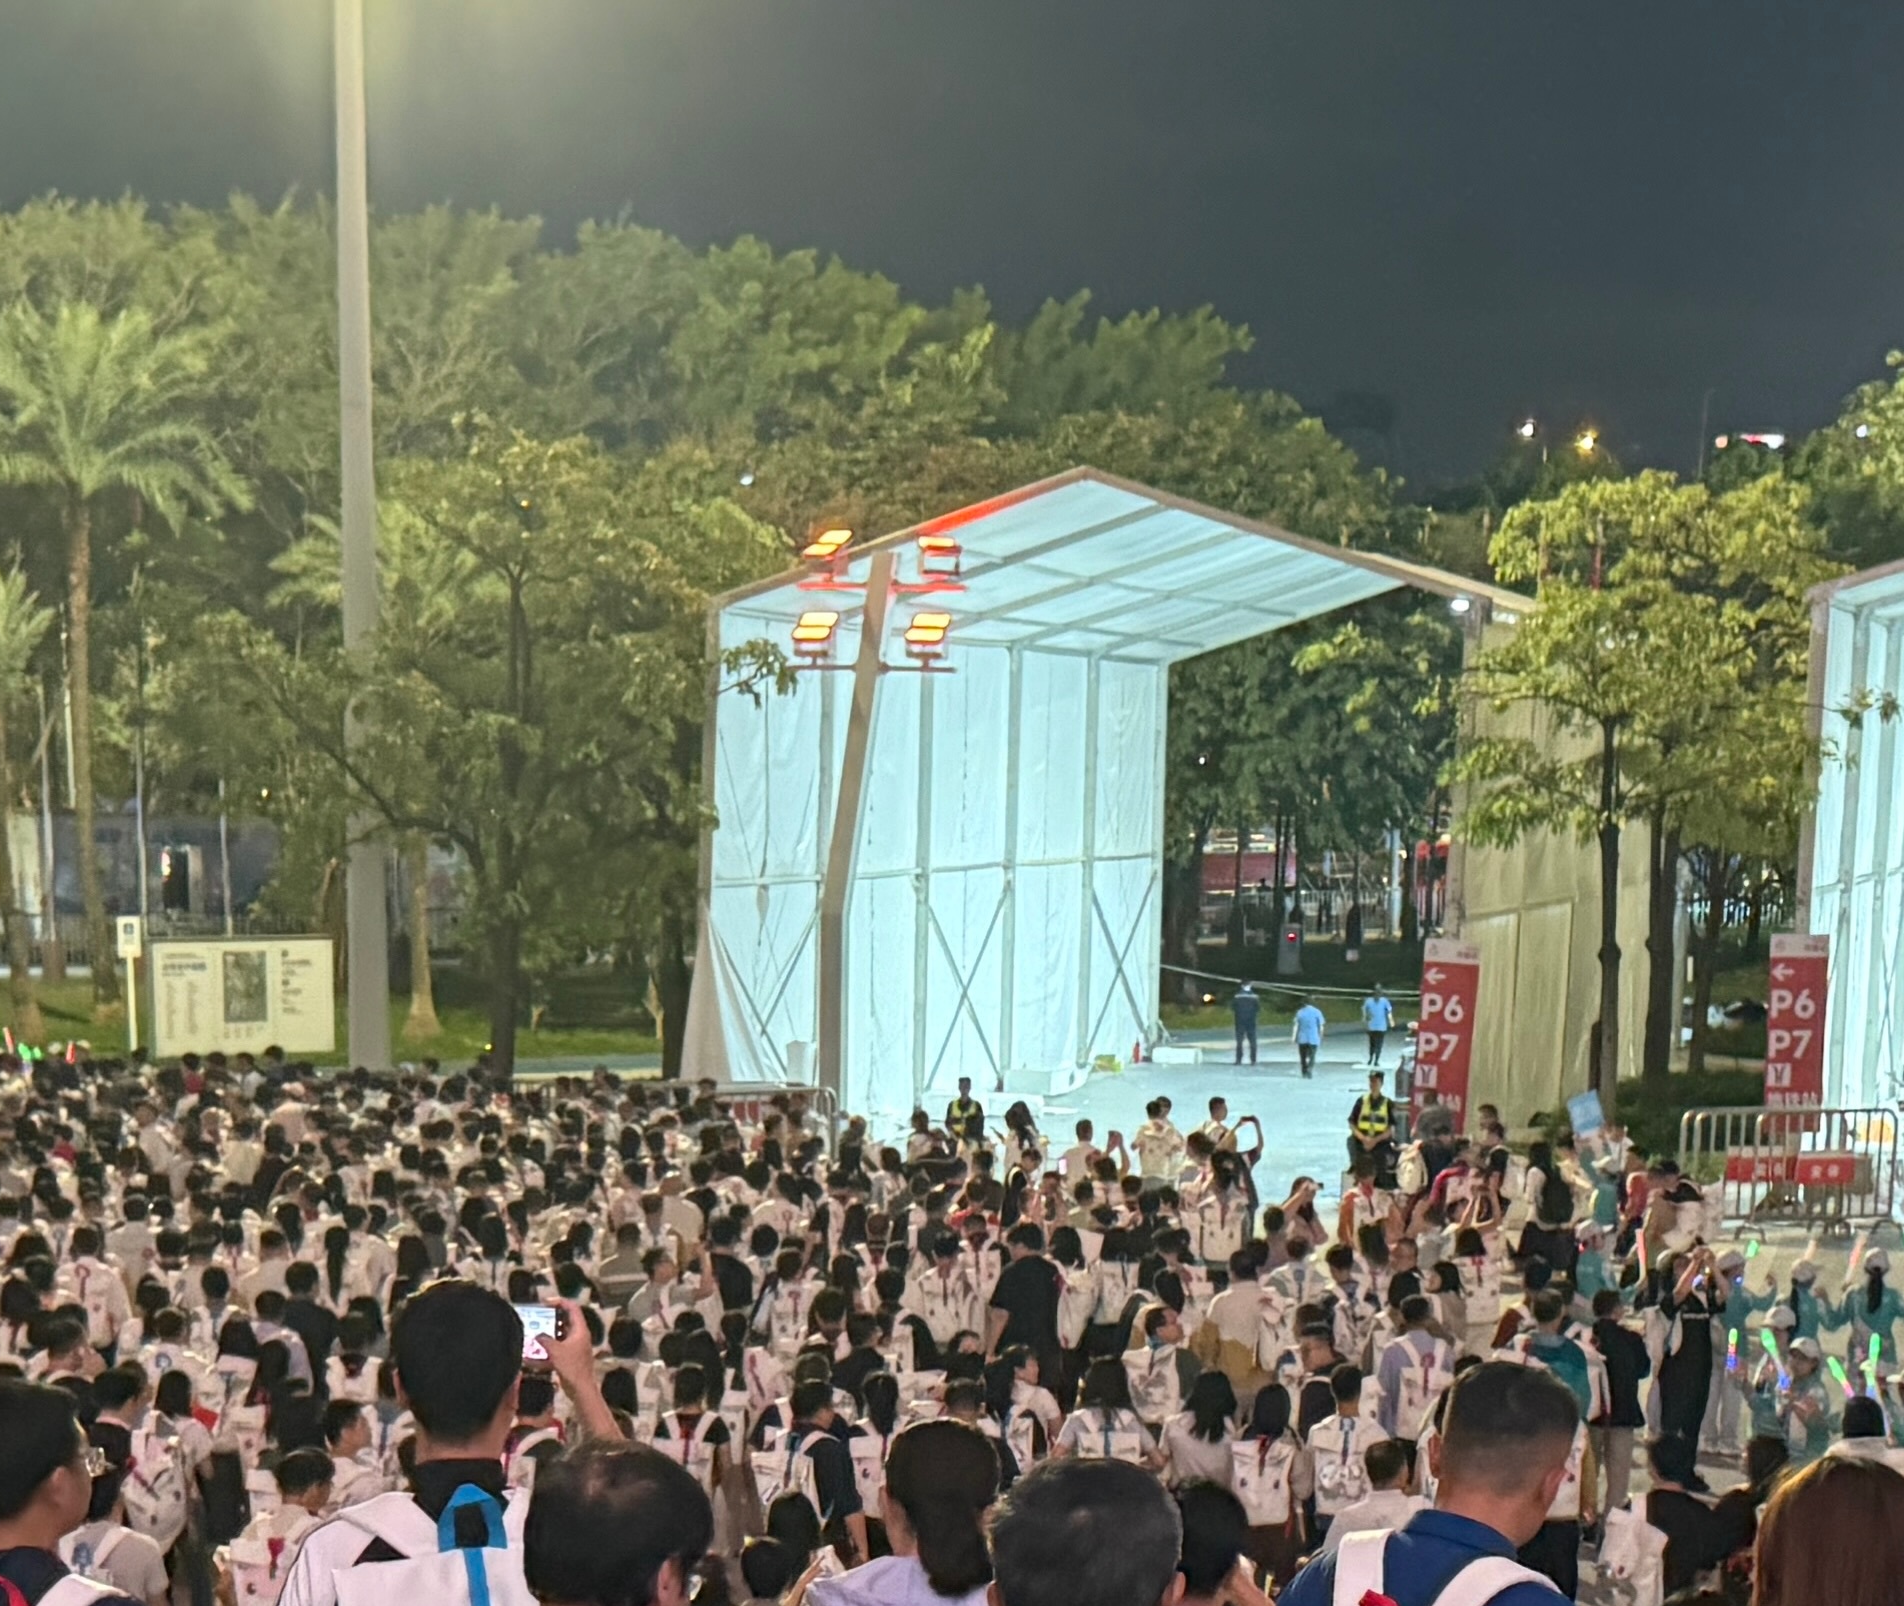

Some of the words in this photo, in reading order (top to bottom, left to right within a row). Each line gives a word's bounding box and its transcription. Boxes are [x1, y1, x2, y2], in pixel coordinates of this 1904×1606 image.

[1421, 993, 1464, 1024] P6
[1770, 988, 1816, 1021] P6
[1418, 1031, 1459, 1062] P7
[1768, 1029, 1813, 1060] P7
